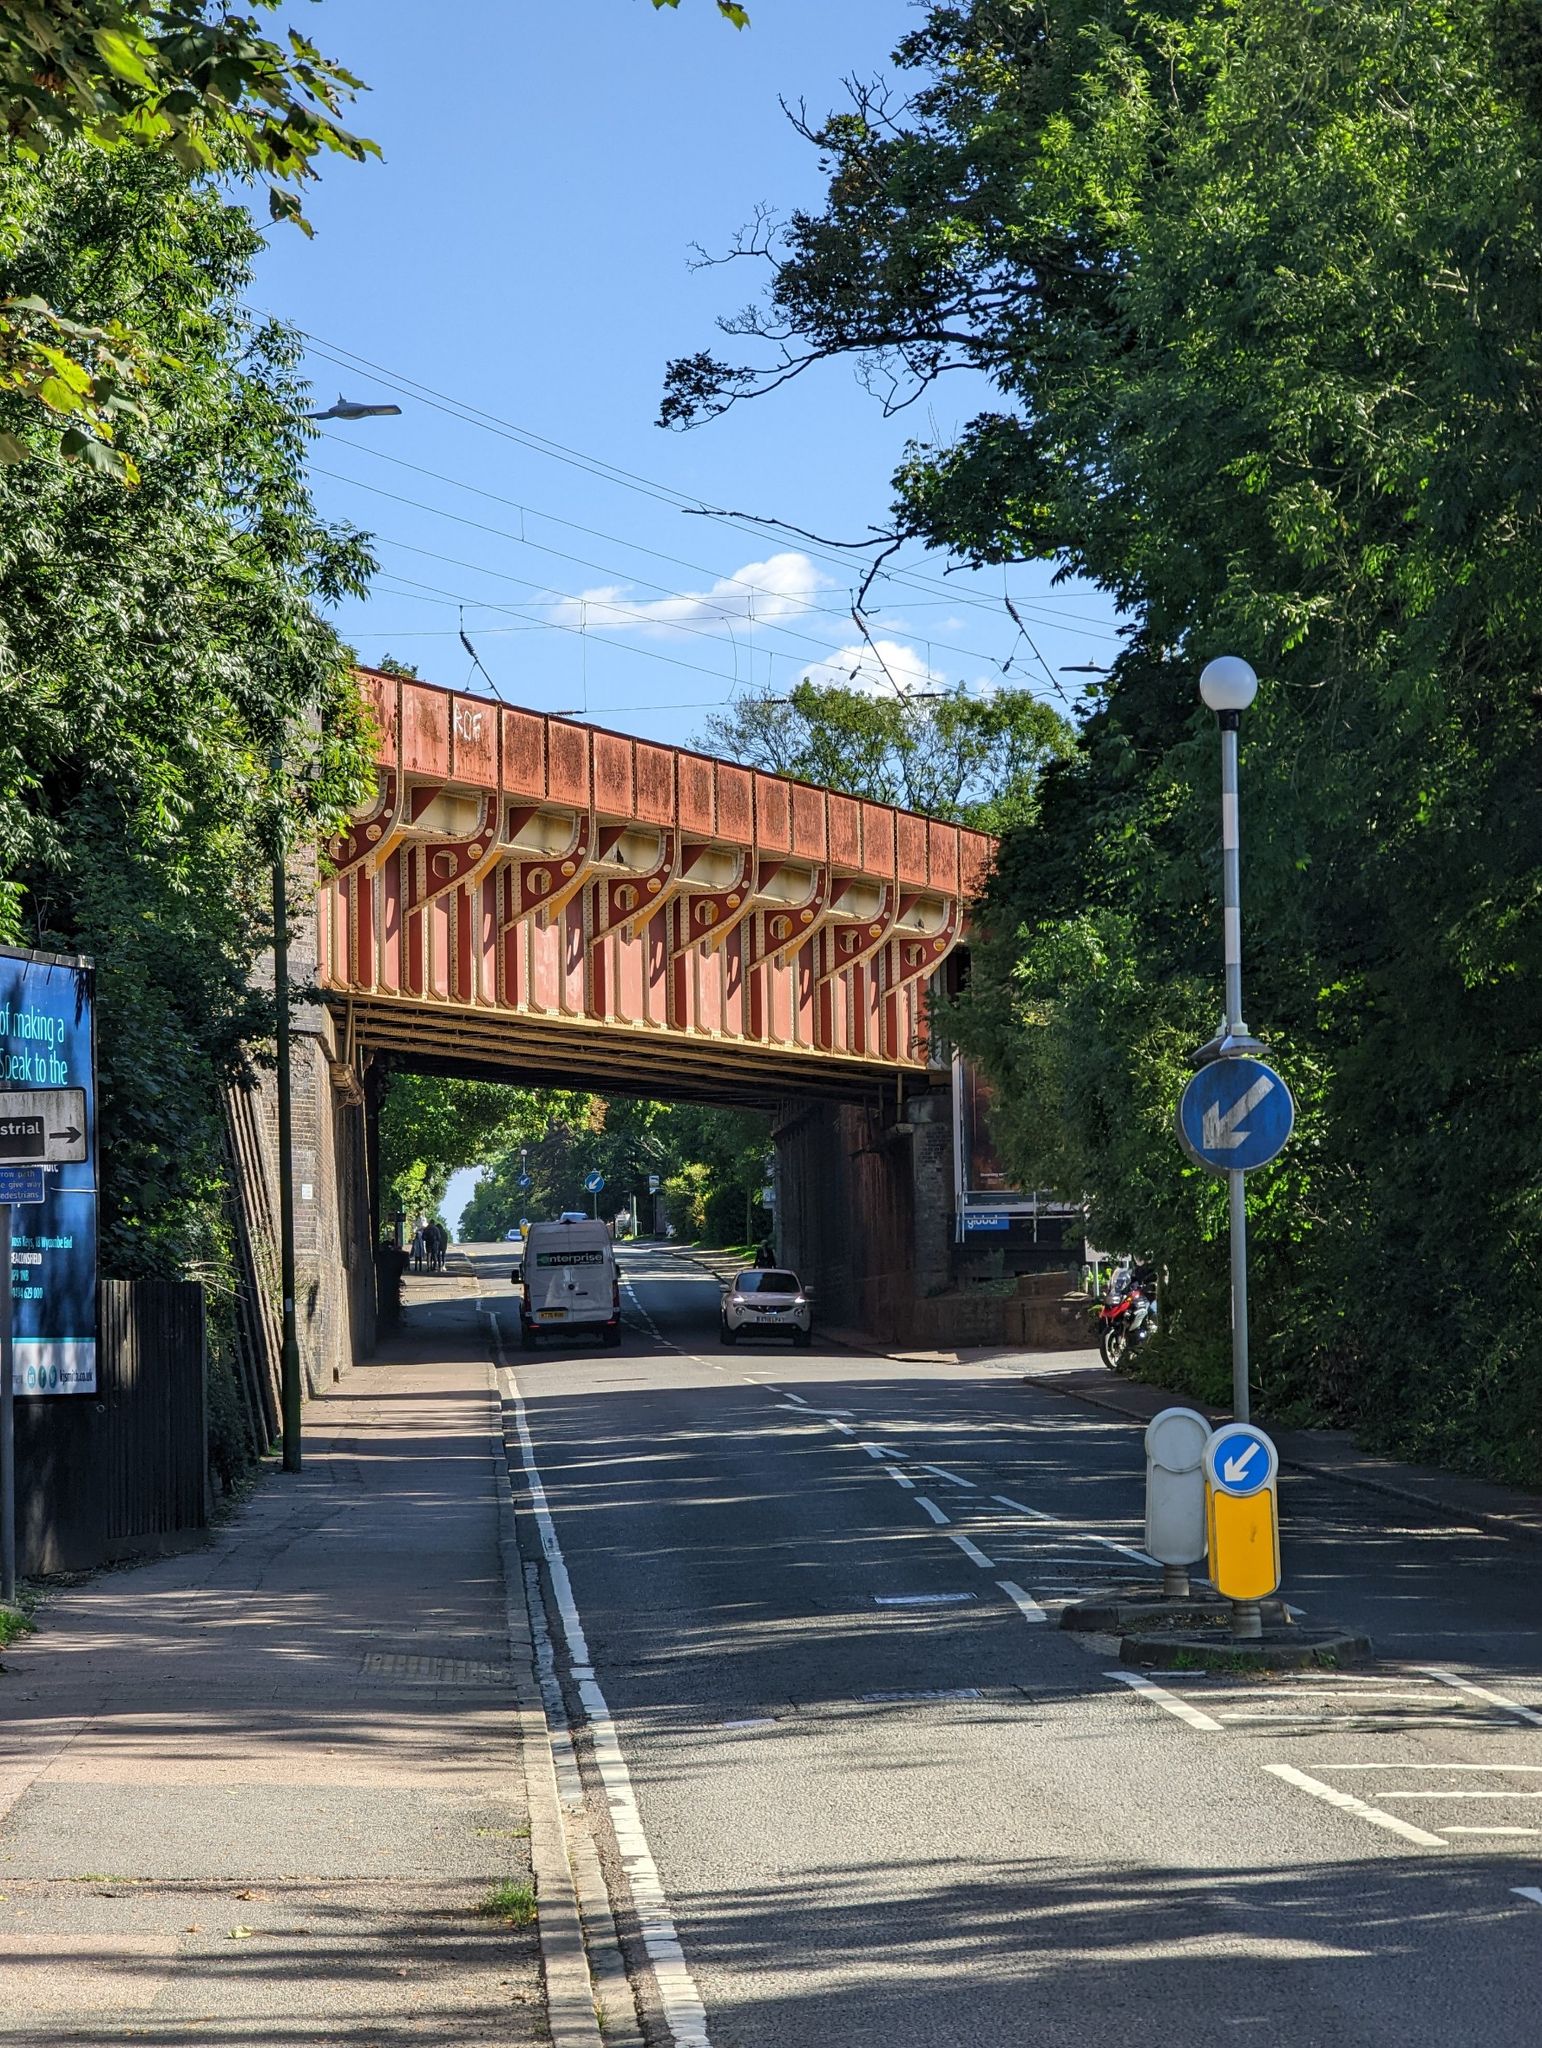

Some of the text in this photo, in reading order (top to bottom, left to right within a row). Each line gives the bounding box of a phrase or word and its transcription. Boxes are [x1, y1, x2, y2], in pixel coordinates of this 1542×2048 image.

[0, 1002, 64, 1050] of making a
[35, 1052, 46, 1082] to
[49, 1050, 68, 1085] the
[0, 1121, 41, 1136] strial
[9, 1182, 23, 1190] give
[967, 1214, 998, 1229] global
[63, 1235, 73, 1249] End
[540, 1252, 602, 1263] enterprise
